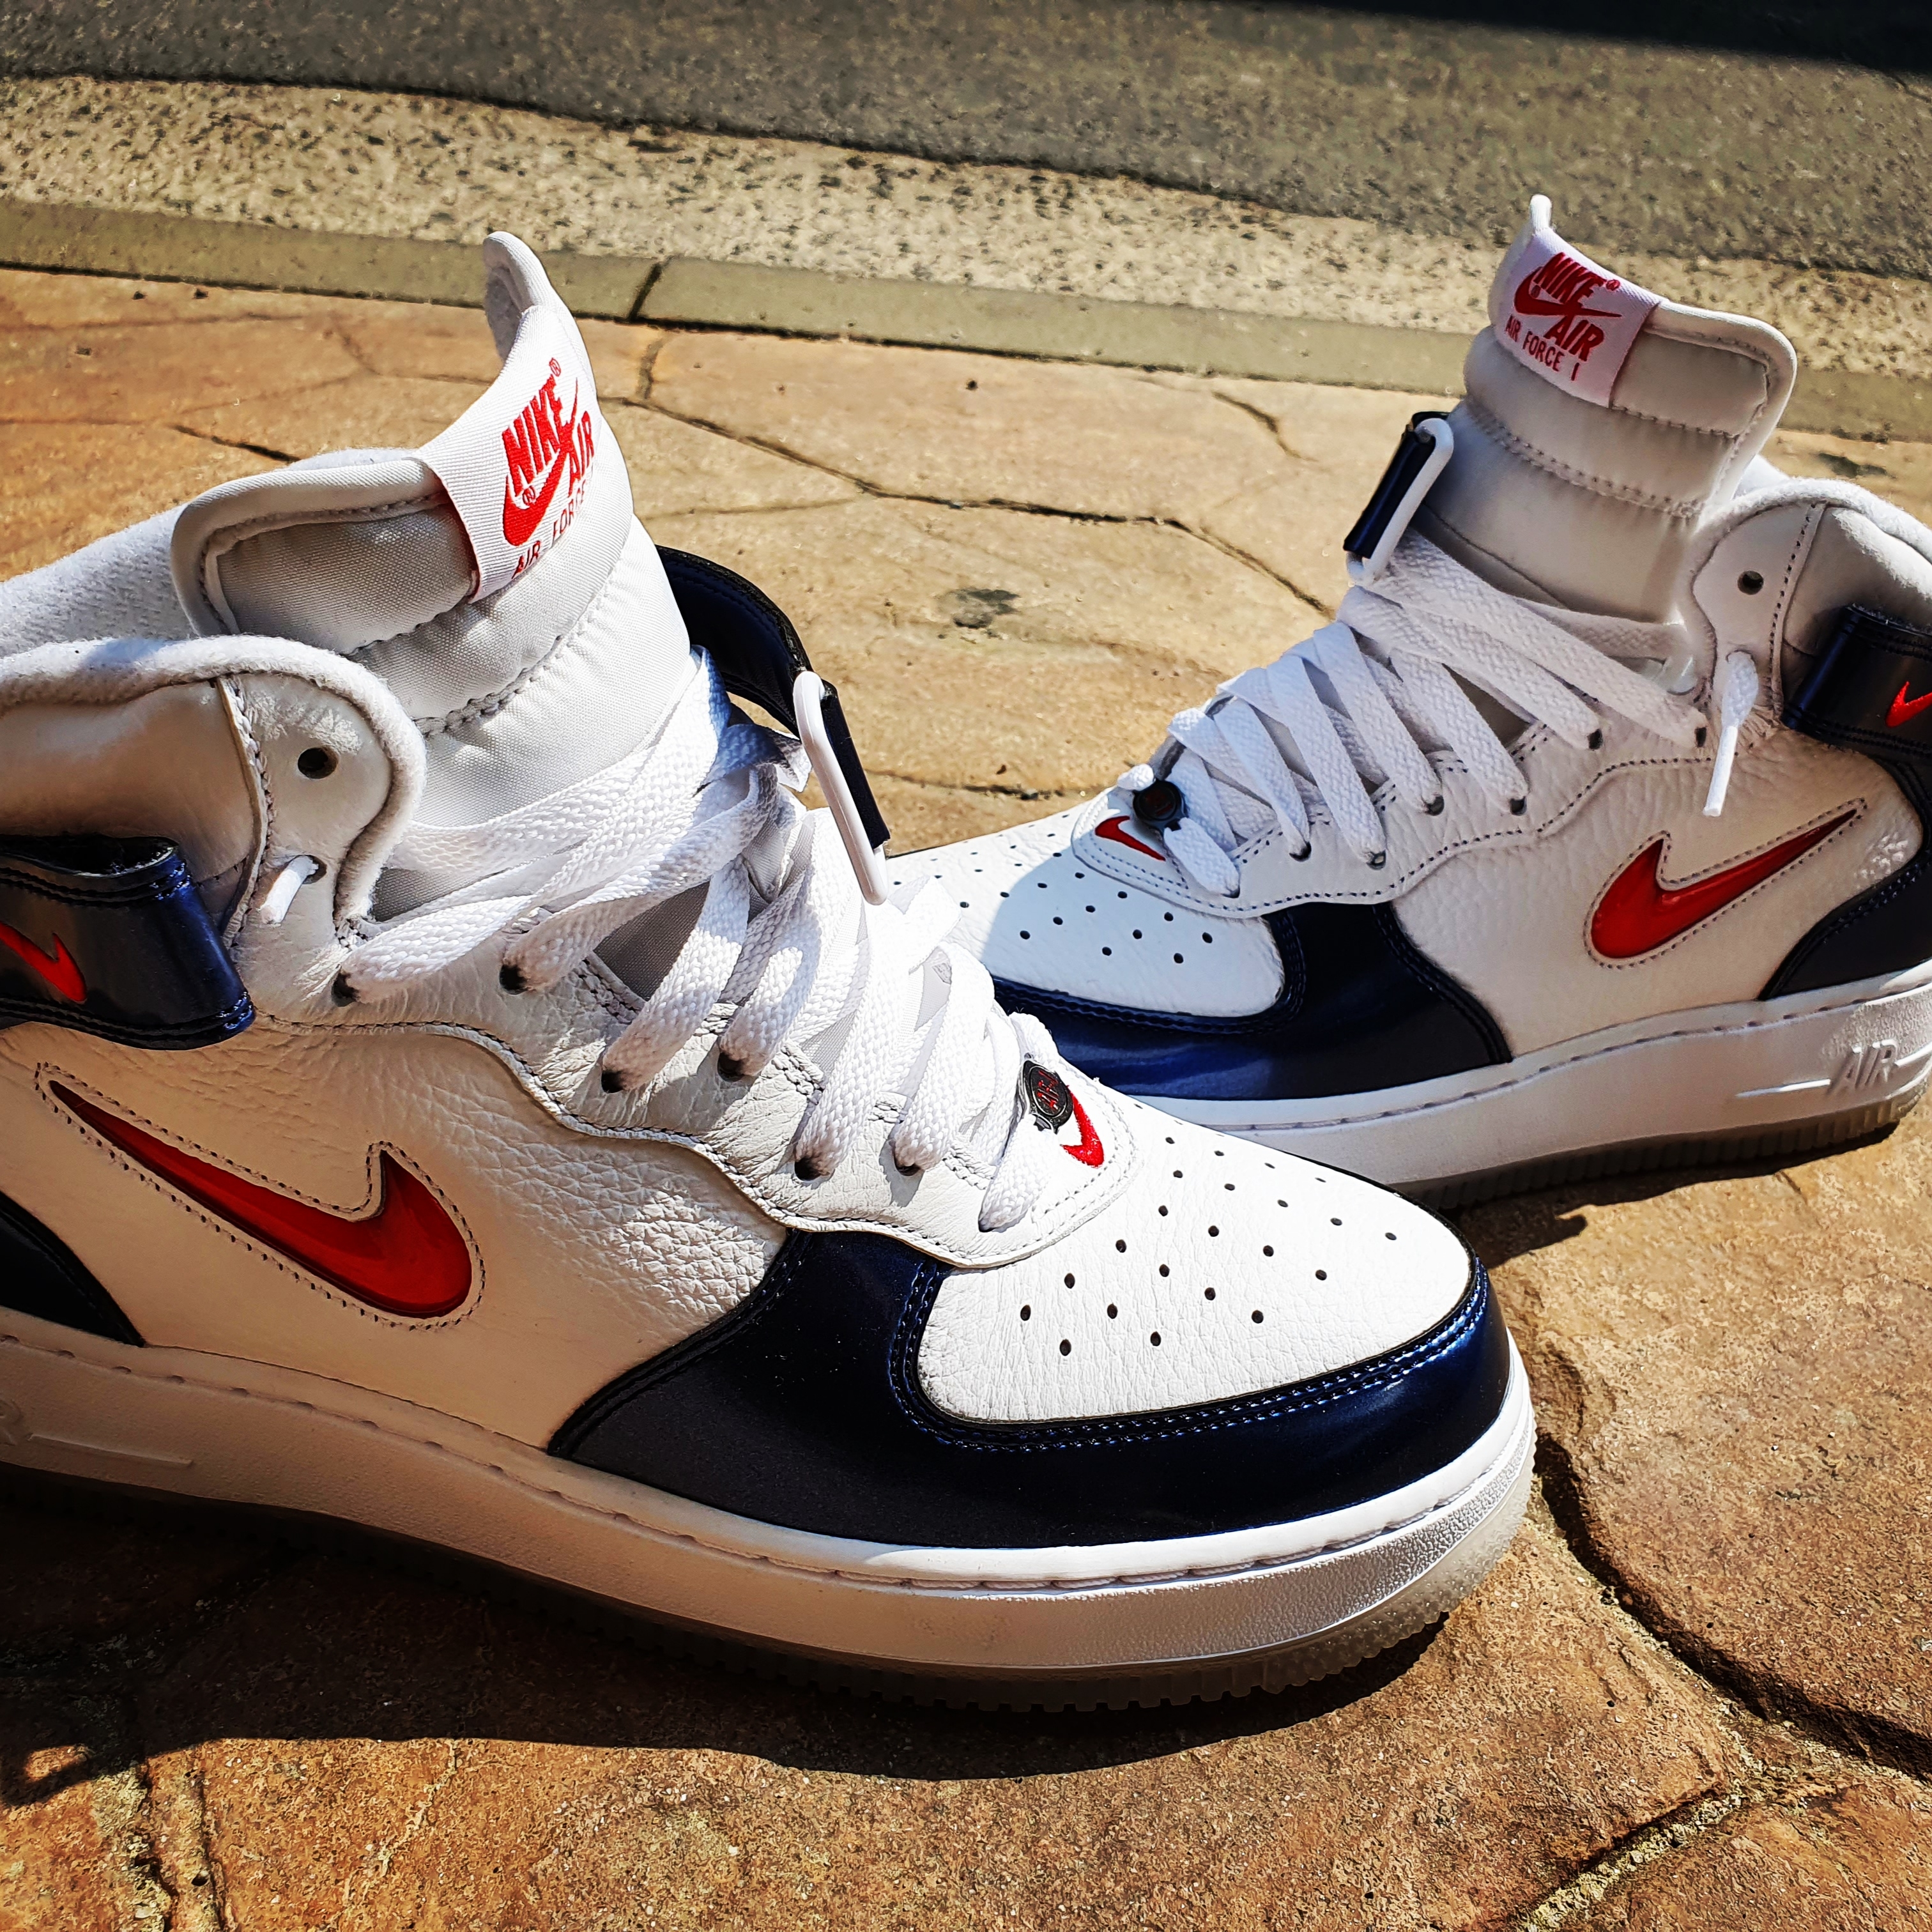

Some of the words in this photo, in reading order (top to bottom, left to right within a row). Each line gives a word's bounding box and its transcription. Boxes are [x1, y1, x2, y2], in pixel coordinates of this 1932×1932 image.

[1533, 252, 1607, 308] NIKE
[1505, 314, 1522, 342] AIR
[1522, 330, 1565, 372] FORCE
[1544, 316, 1605, 362] AIR
[502, 374, 565, 497] NIKE
[567, 410, 595, 498] AIR
[512, 540, 541, 579] AIR
[1826, 1039, 1898, 1095] AIR
